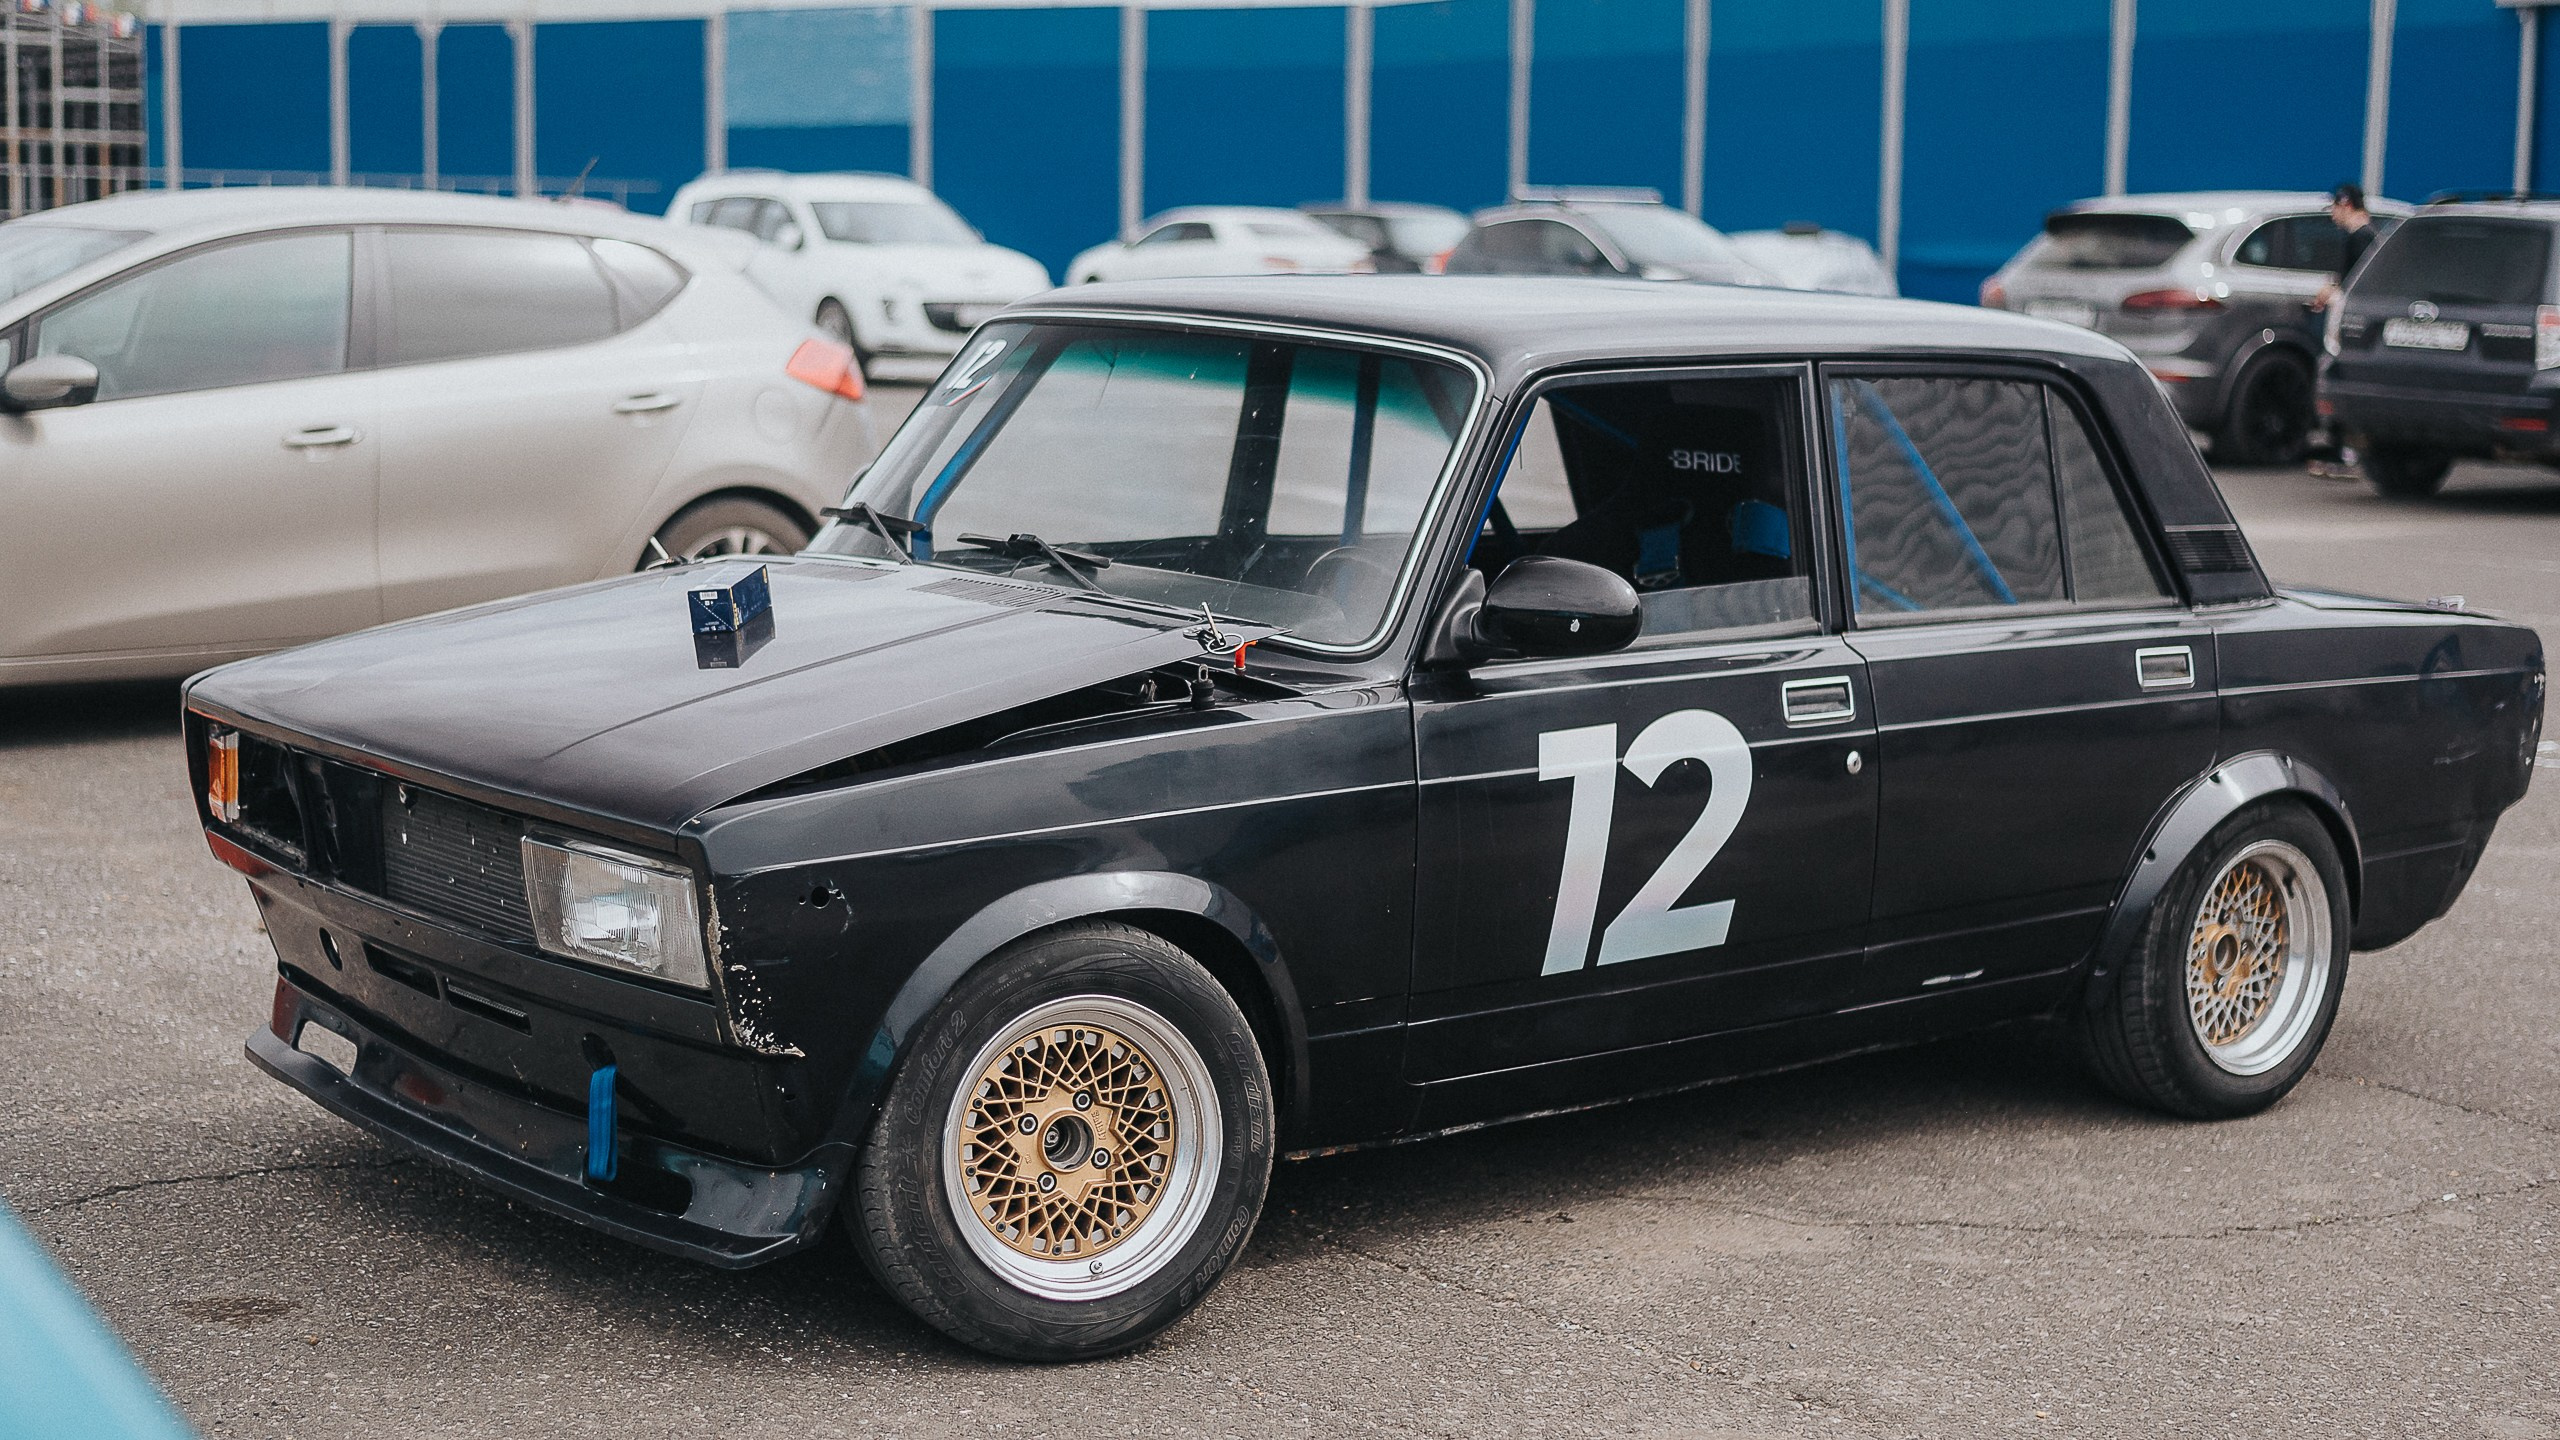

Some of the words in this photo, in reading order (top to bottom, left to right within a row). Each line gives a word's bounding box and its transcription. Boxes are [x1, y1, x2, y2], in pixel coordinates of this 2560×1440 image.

[945, 338, 1009, 390] 12
[1539, 708, 1753, 977] 12
[903, 1027, 954, 1126] Comfort
[951, 1009, 968, 1038] 2
[1224, 1031, 1265, 1155] Cordiant
[1179, 1281, 1193, 1308] 2
[1195, 1205, 1250, 1292] Comfort
